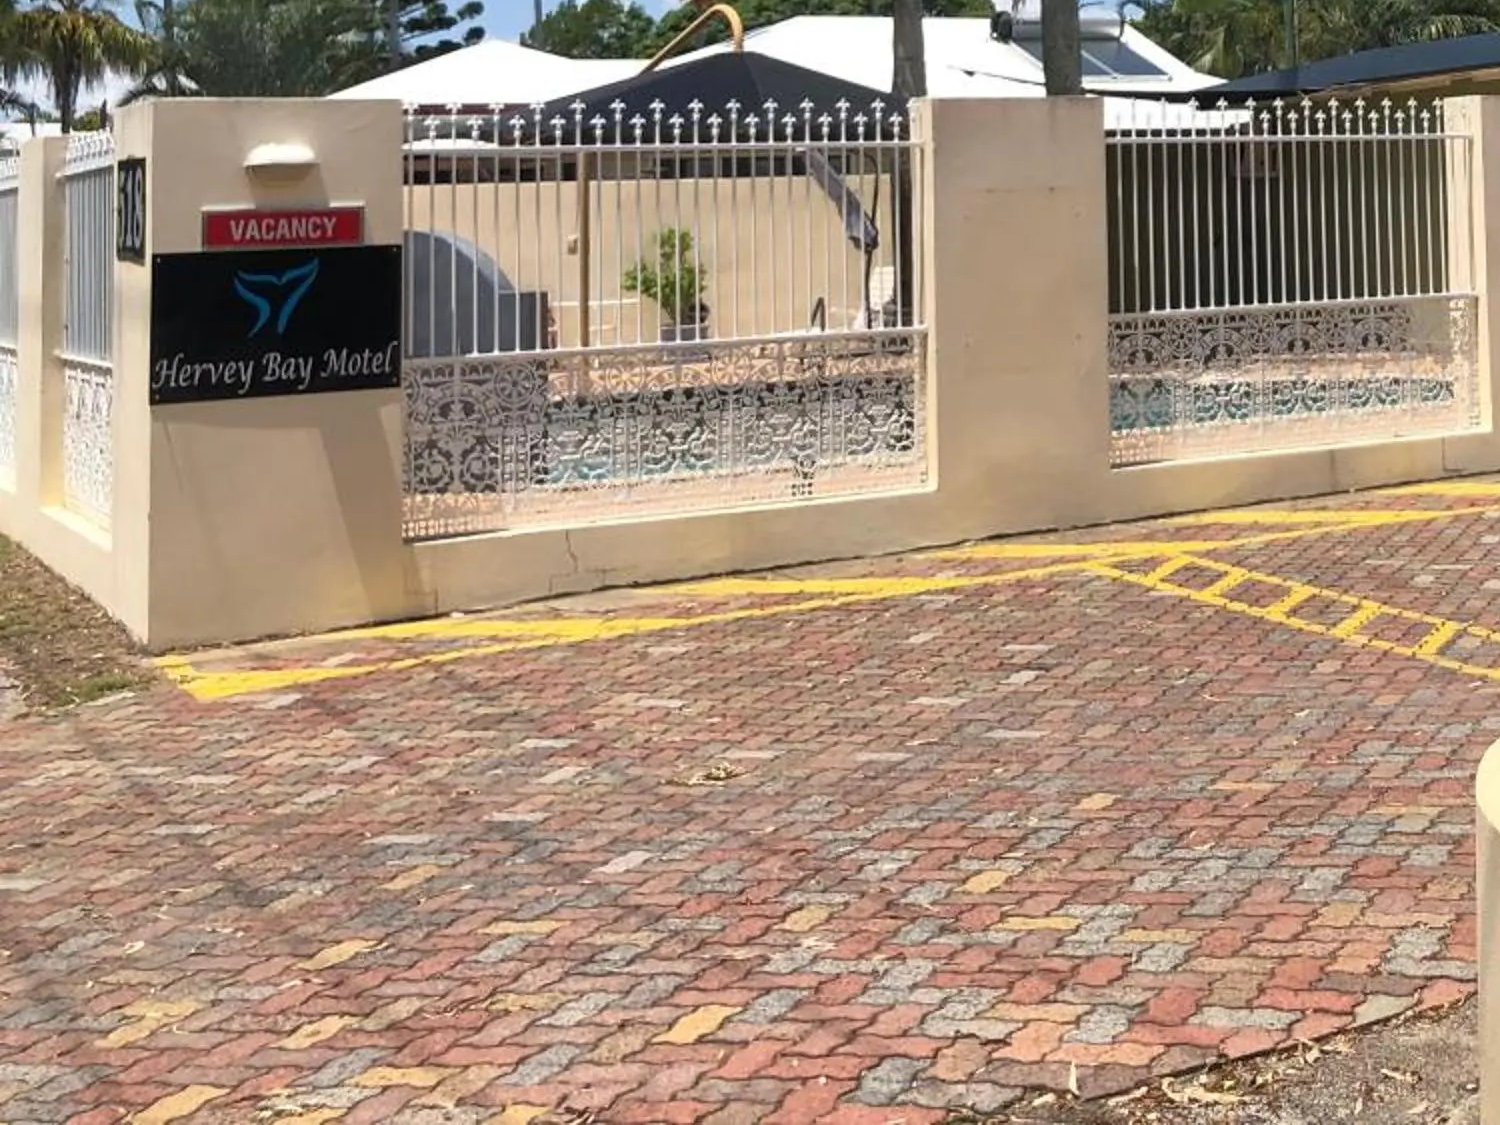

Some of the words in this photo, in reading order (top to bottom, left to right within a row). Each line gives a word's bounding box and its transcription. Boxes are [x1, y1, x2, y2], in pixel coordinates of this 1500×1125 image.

[230, 216, 337, 242] VACANCY
[152, 353, 254, 395] Hervey
[262, 352, 314, 390] Bay
[321, 340, 399, 377] Motel
